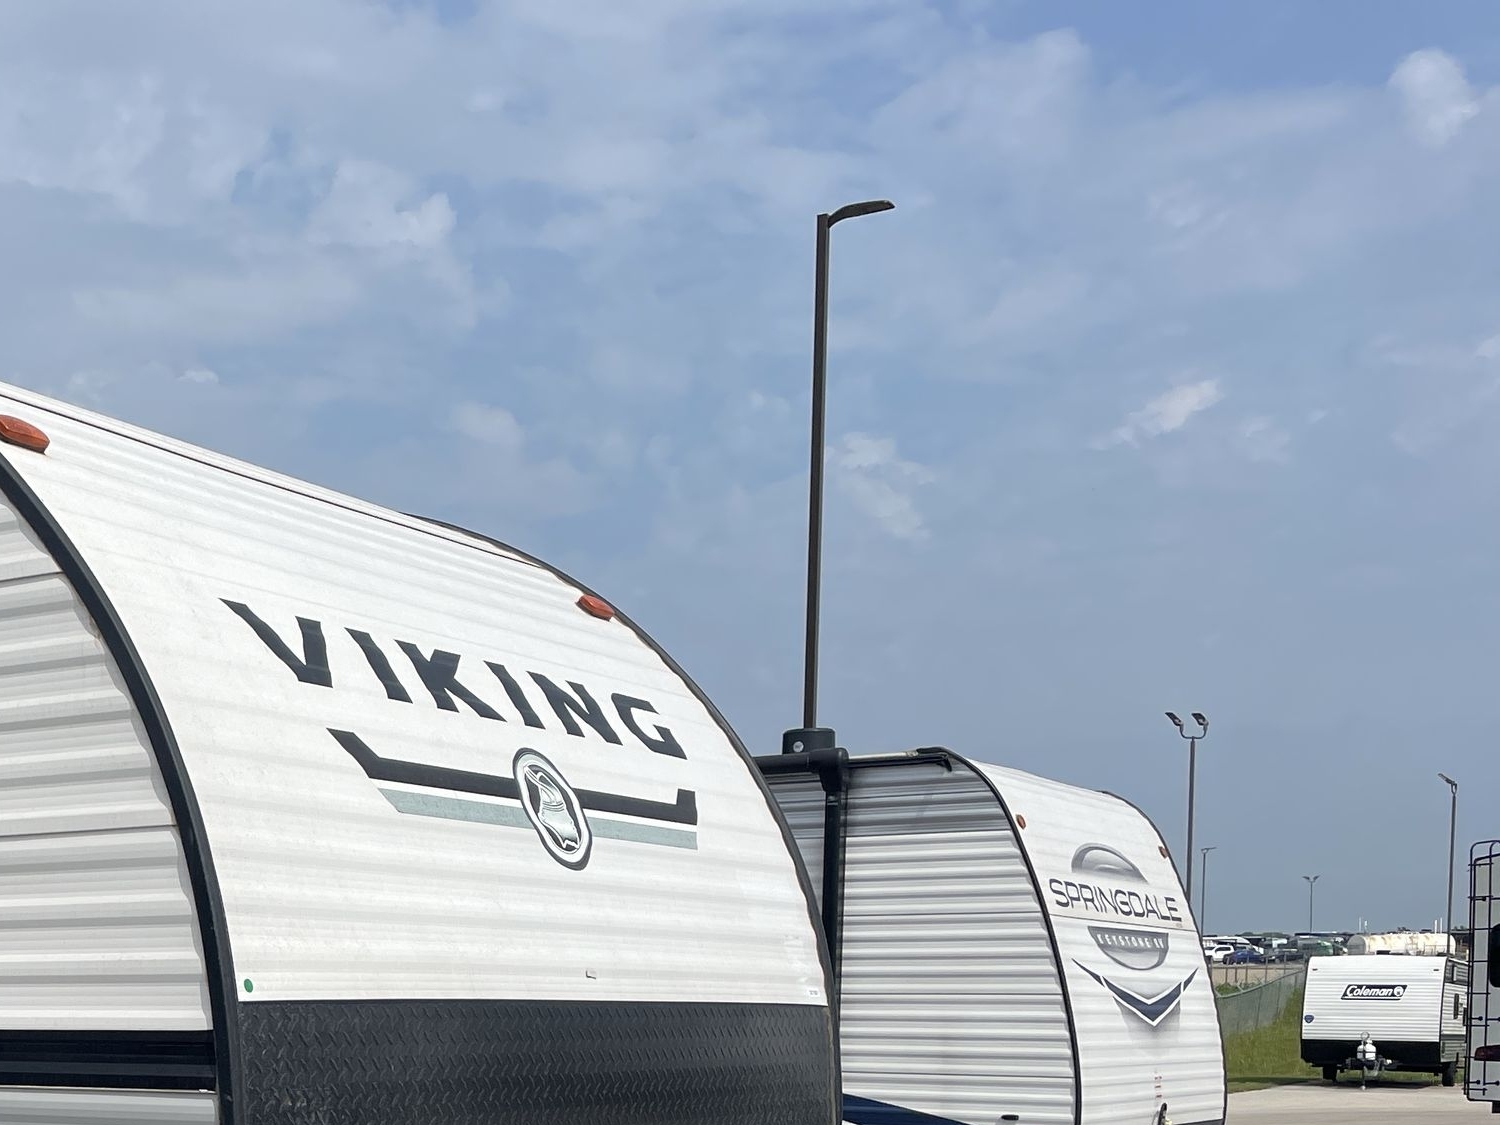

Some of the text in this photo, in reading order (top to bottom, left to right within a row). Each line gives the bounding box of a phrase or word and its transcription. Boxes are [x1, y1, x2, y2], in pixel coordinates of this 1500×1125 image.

[218, 598, 688, 760] VIKING
[1049, 878, 1183, 922] SPRINGDALE
[1096, 933, 1152, 948] KEYSTONE
[1346, 985, 1394, 998] Coleman
